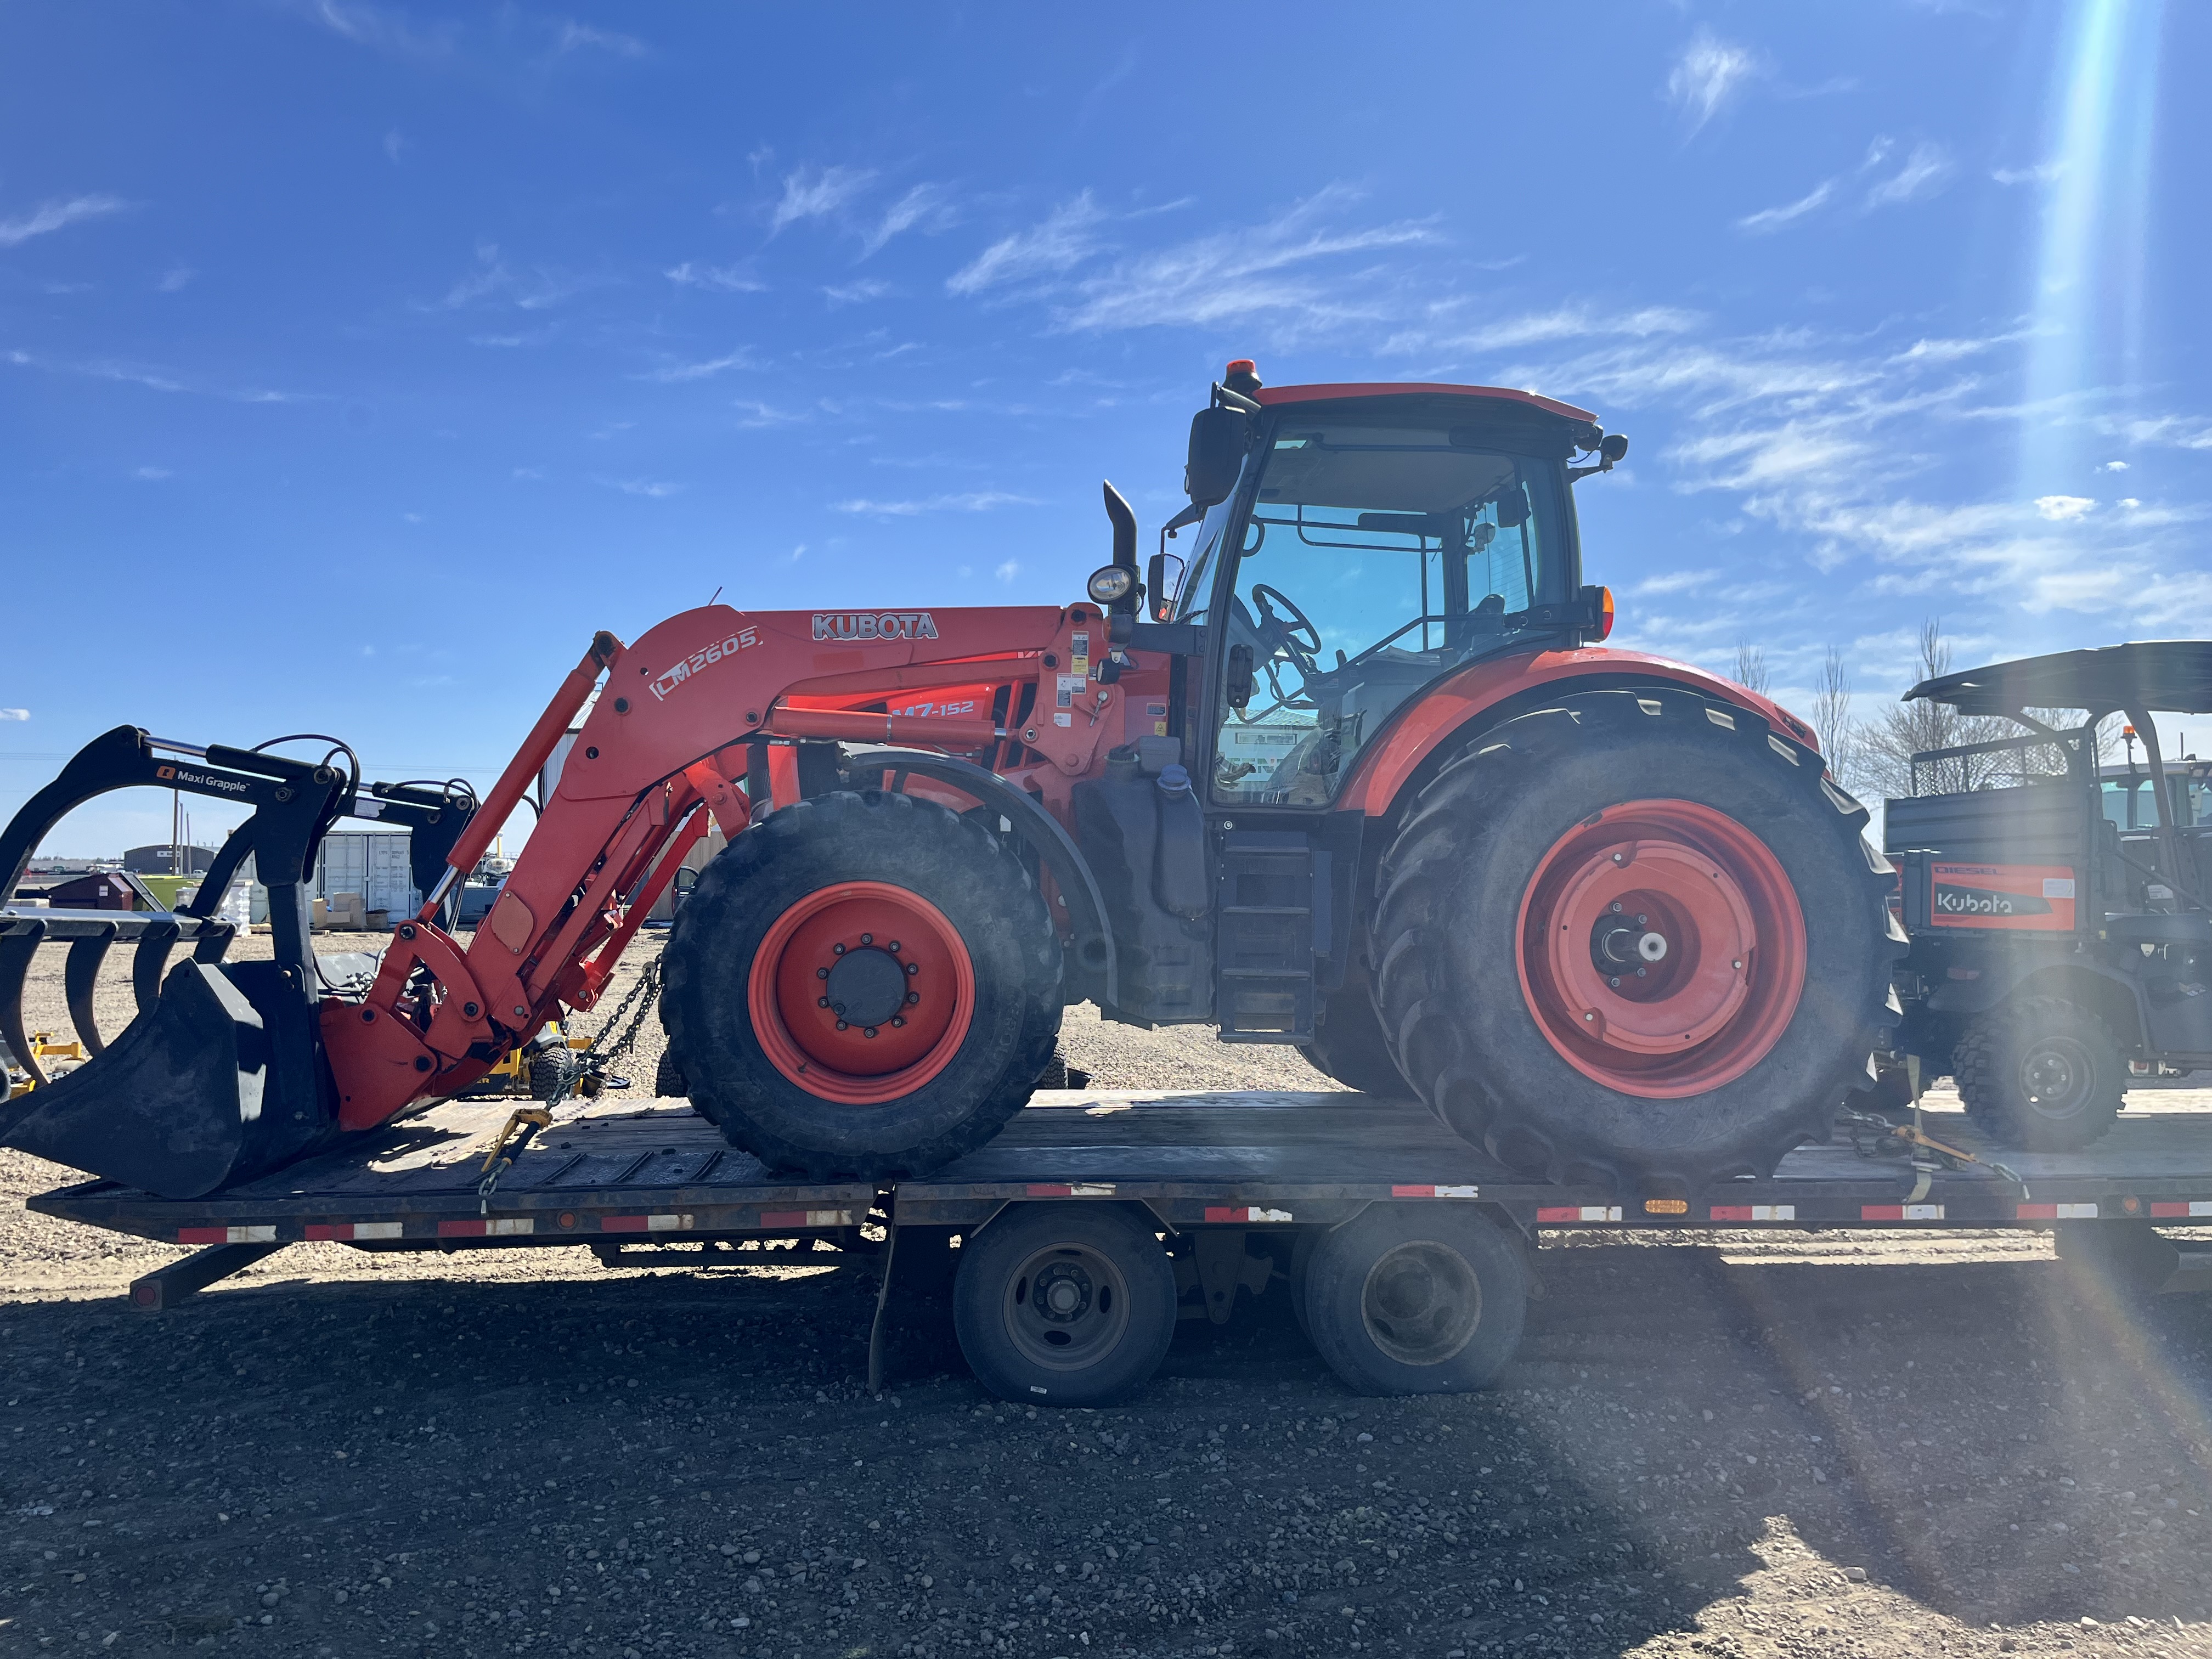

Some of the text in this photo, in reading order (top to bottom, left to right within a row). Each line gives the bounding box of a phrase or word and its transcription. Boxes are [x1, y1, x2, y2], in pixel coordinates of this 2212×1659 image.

[814, 614, 938, 639] KUBOTA
[656, 630, 757, 696] LM2605
[178, 770, 204, 784] Maxi
[1934, 866, 2000, 875] DIESEL
[1938, 893, 2012, 913] Kubota
